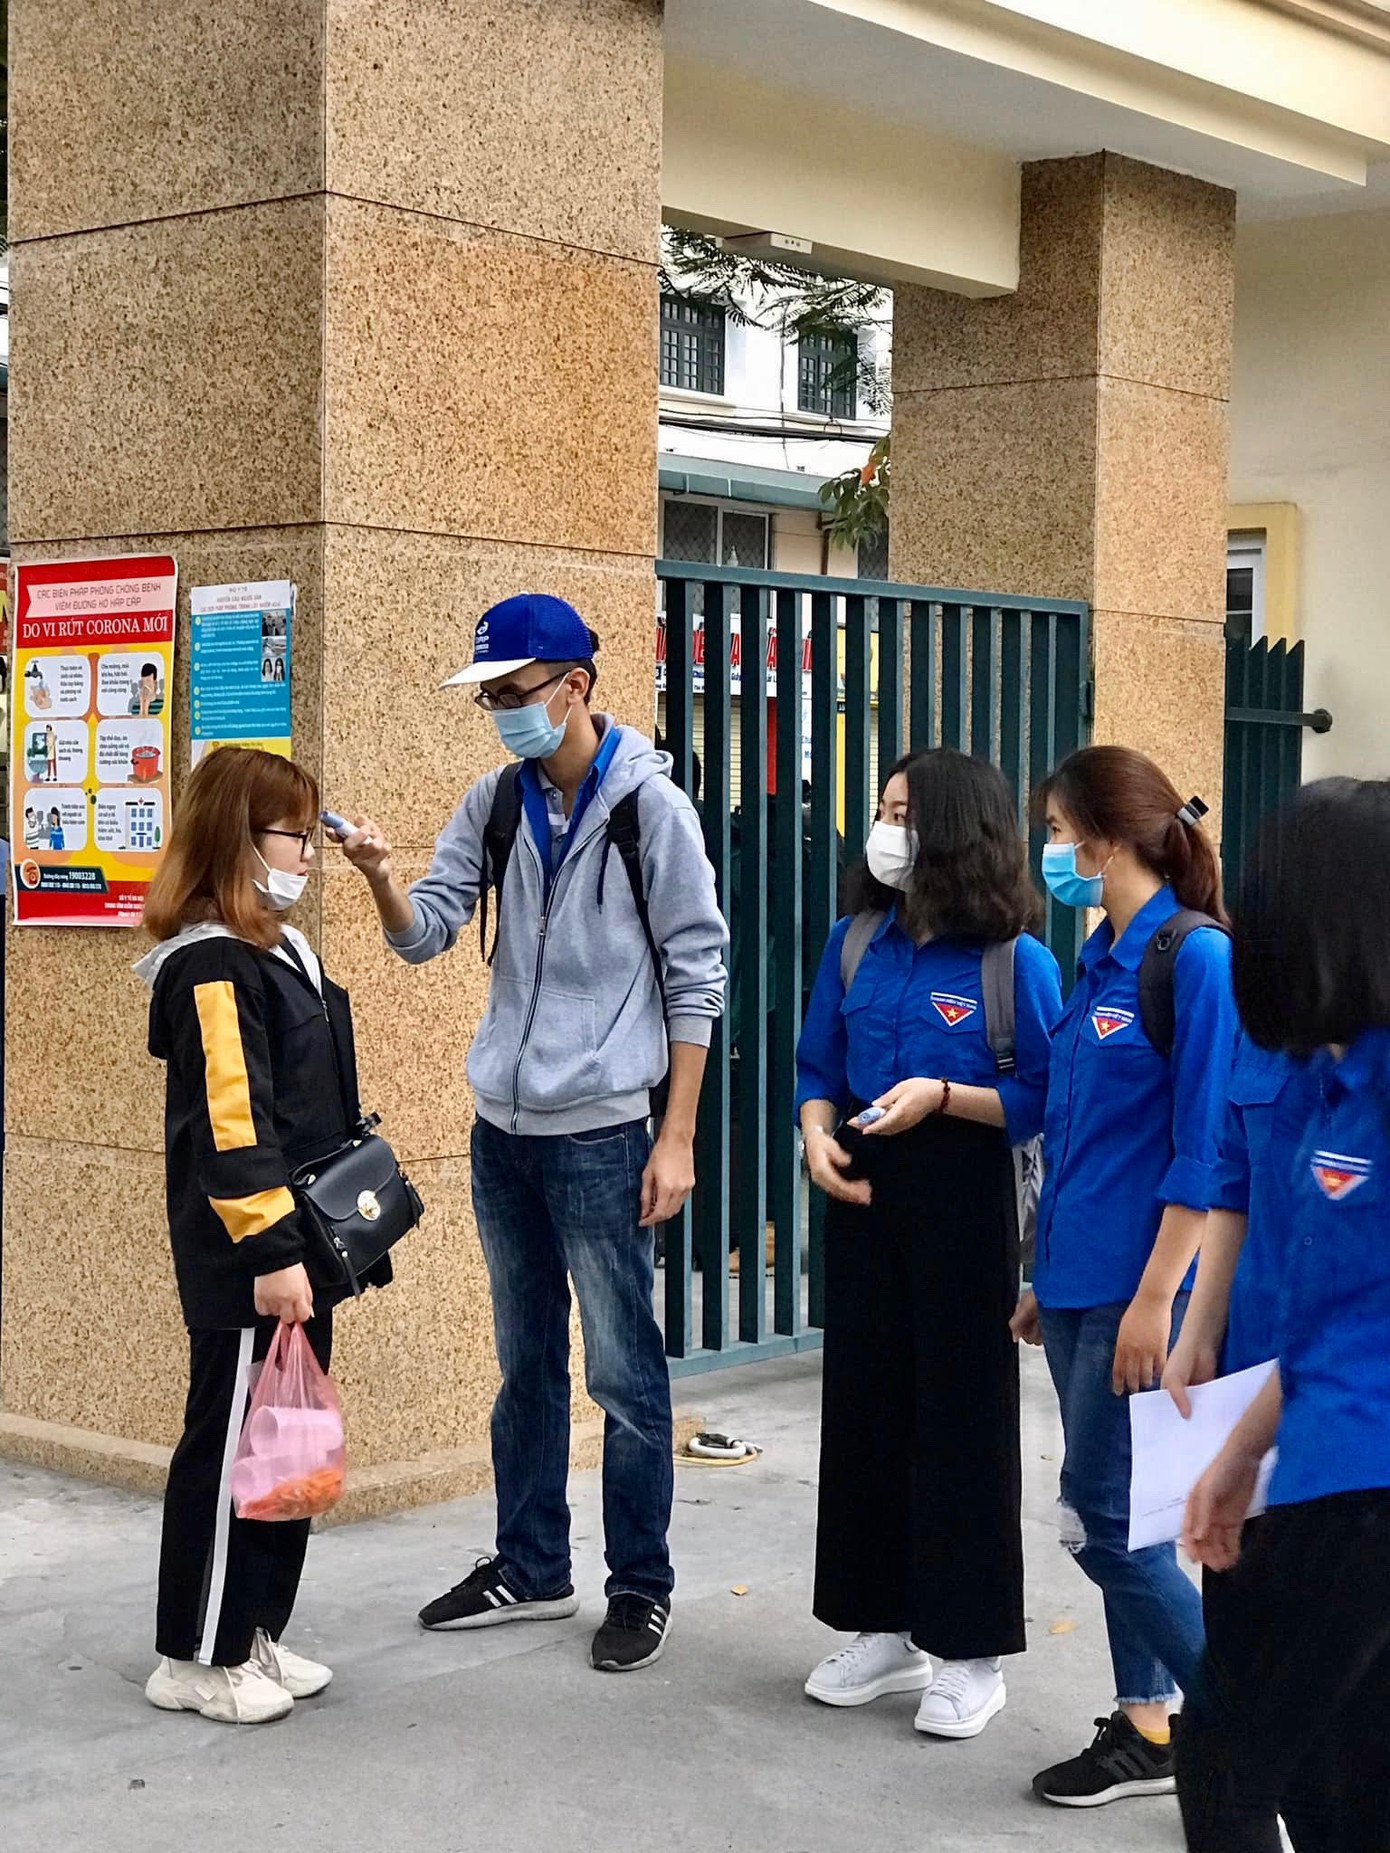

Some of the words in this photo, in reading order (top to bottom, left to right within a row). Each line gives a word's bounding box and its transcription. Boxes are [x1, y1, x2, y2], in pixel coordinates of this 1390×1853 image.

[23, 623, 40, 638] DO
[42, 622, 56, 637] VI
[58, 617, 84, 636] RÚT
[86, 617, 140, 636] CORONA
